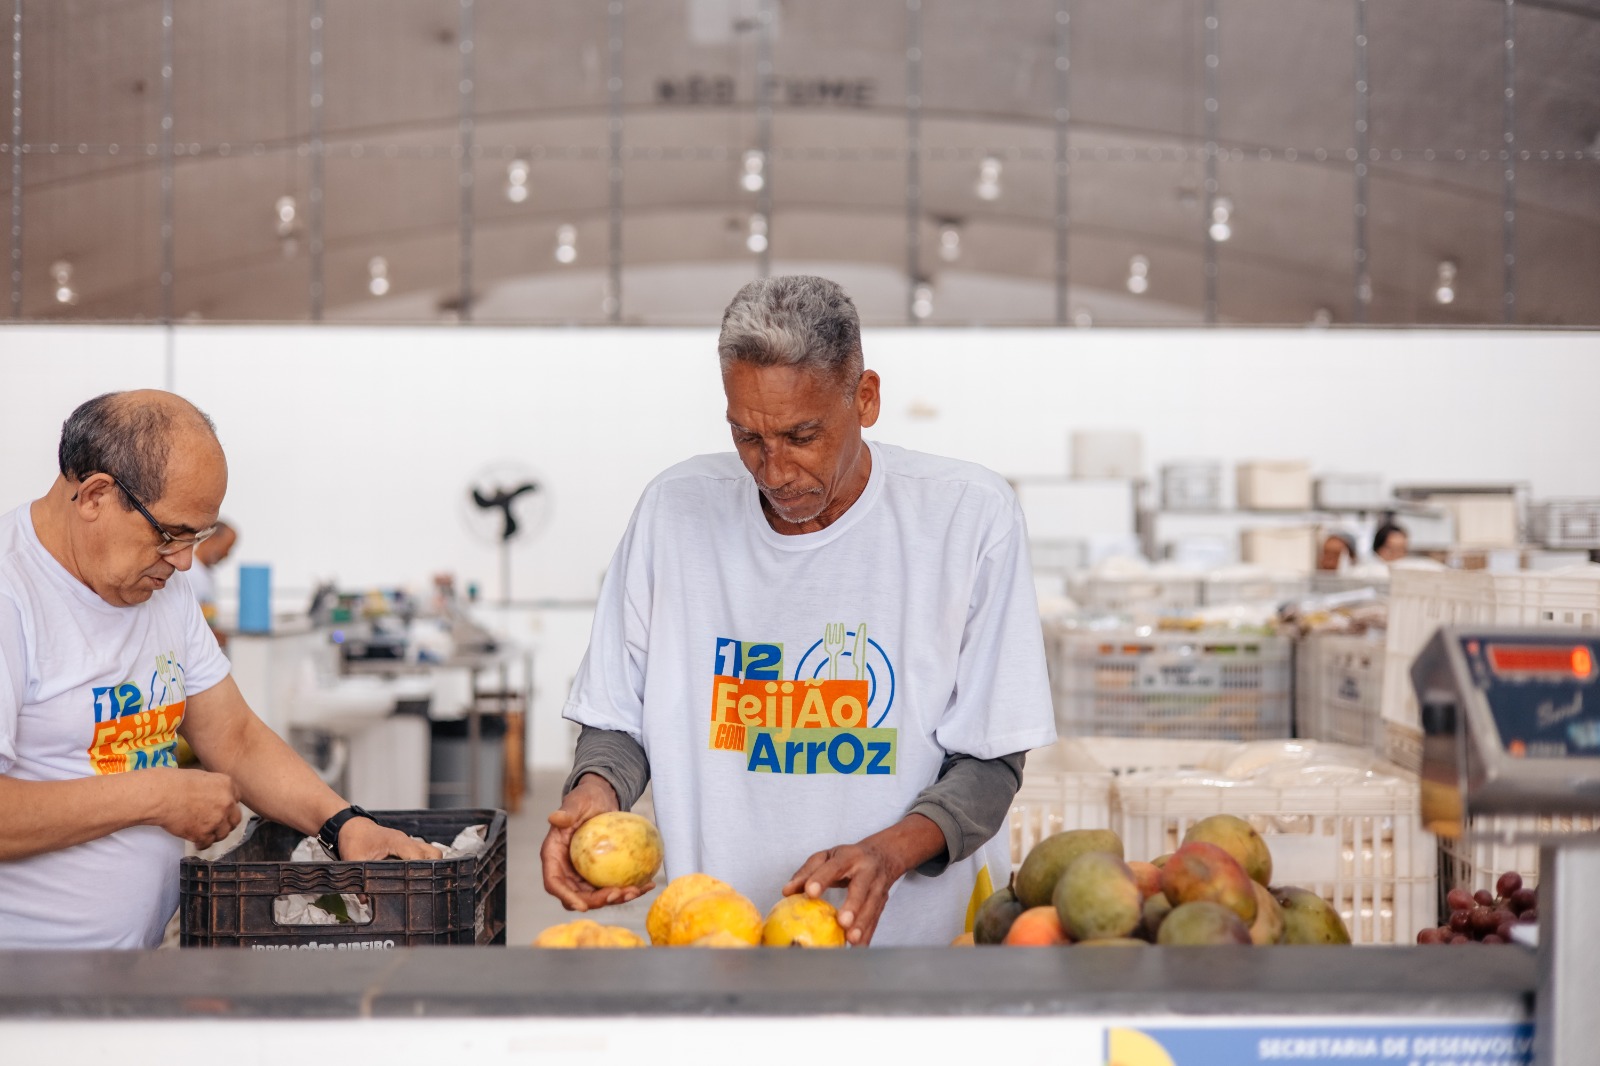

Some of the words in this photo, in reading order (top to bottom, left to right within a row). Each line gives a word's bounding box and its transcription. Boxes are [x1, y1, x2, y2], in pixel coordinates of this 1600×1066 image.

[747, 733, 892, 775] ArrOz
[1259, 1038, 1378, 1058] SECRETARIA
[1382, 1037, 1408, 1057] DE
